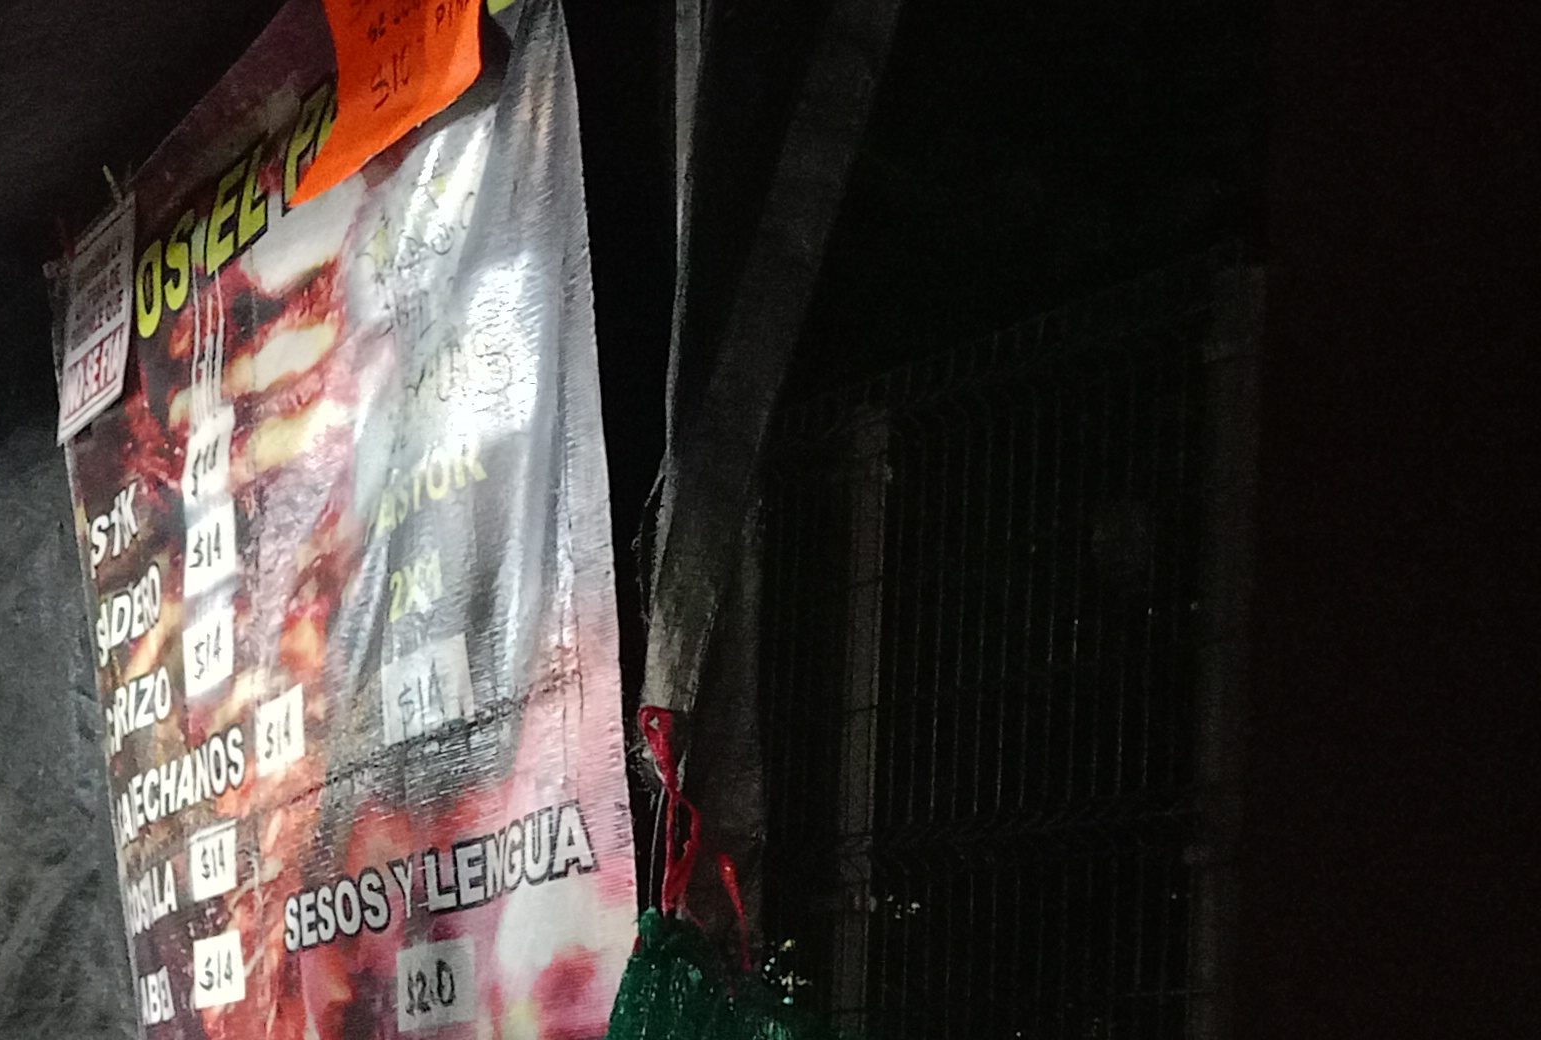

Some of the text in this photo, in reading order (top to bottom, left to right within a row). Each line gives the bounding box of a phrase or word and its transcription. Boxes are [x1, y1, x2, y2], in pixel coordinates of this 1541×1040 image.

[207, 146, 267, 276] EL
[284, 85, 336, 206] P
[369, 447, 488, 540] ASTOR
[106, 667, 171, 752] RIZO
[283, 803, 595, 953] SESOS Y LENGUA
